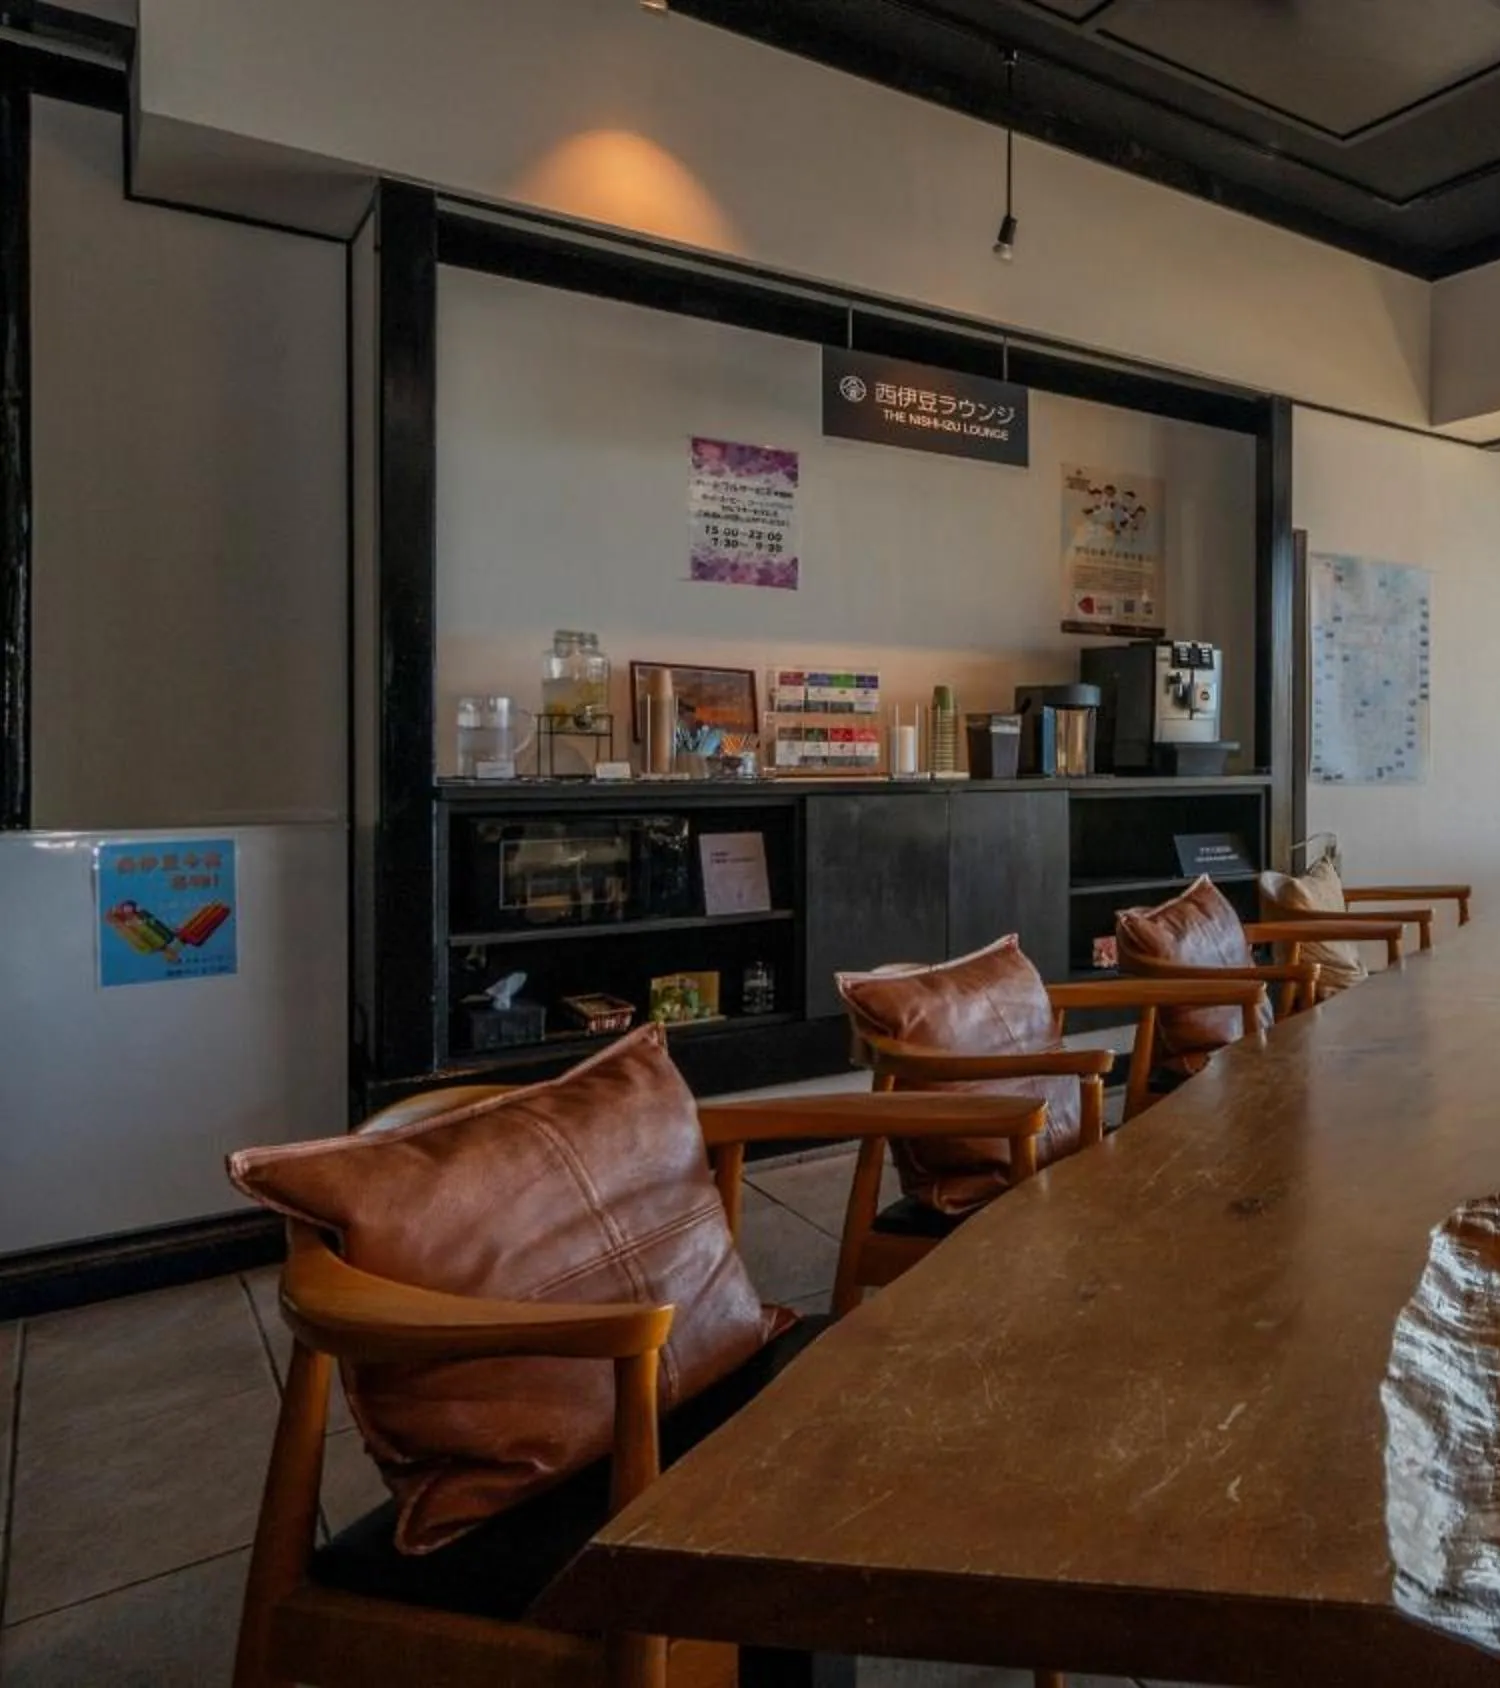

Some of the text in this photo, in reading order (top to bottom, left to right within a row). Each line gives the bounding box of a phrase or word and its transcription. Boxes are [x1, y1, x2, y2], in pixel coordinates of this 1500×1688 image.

[874, 382, 1015, 424] 西伊豆ラウンジ
[883, 409, 1009, 441] THE NISHI-IZU LOUNGE
